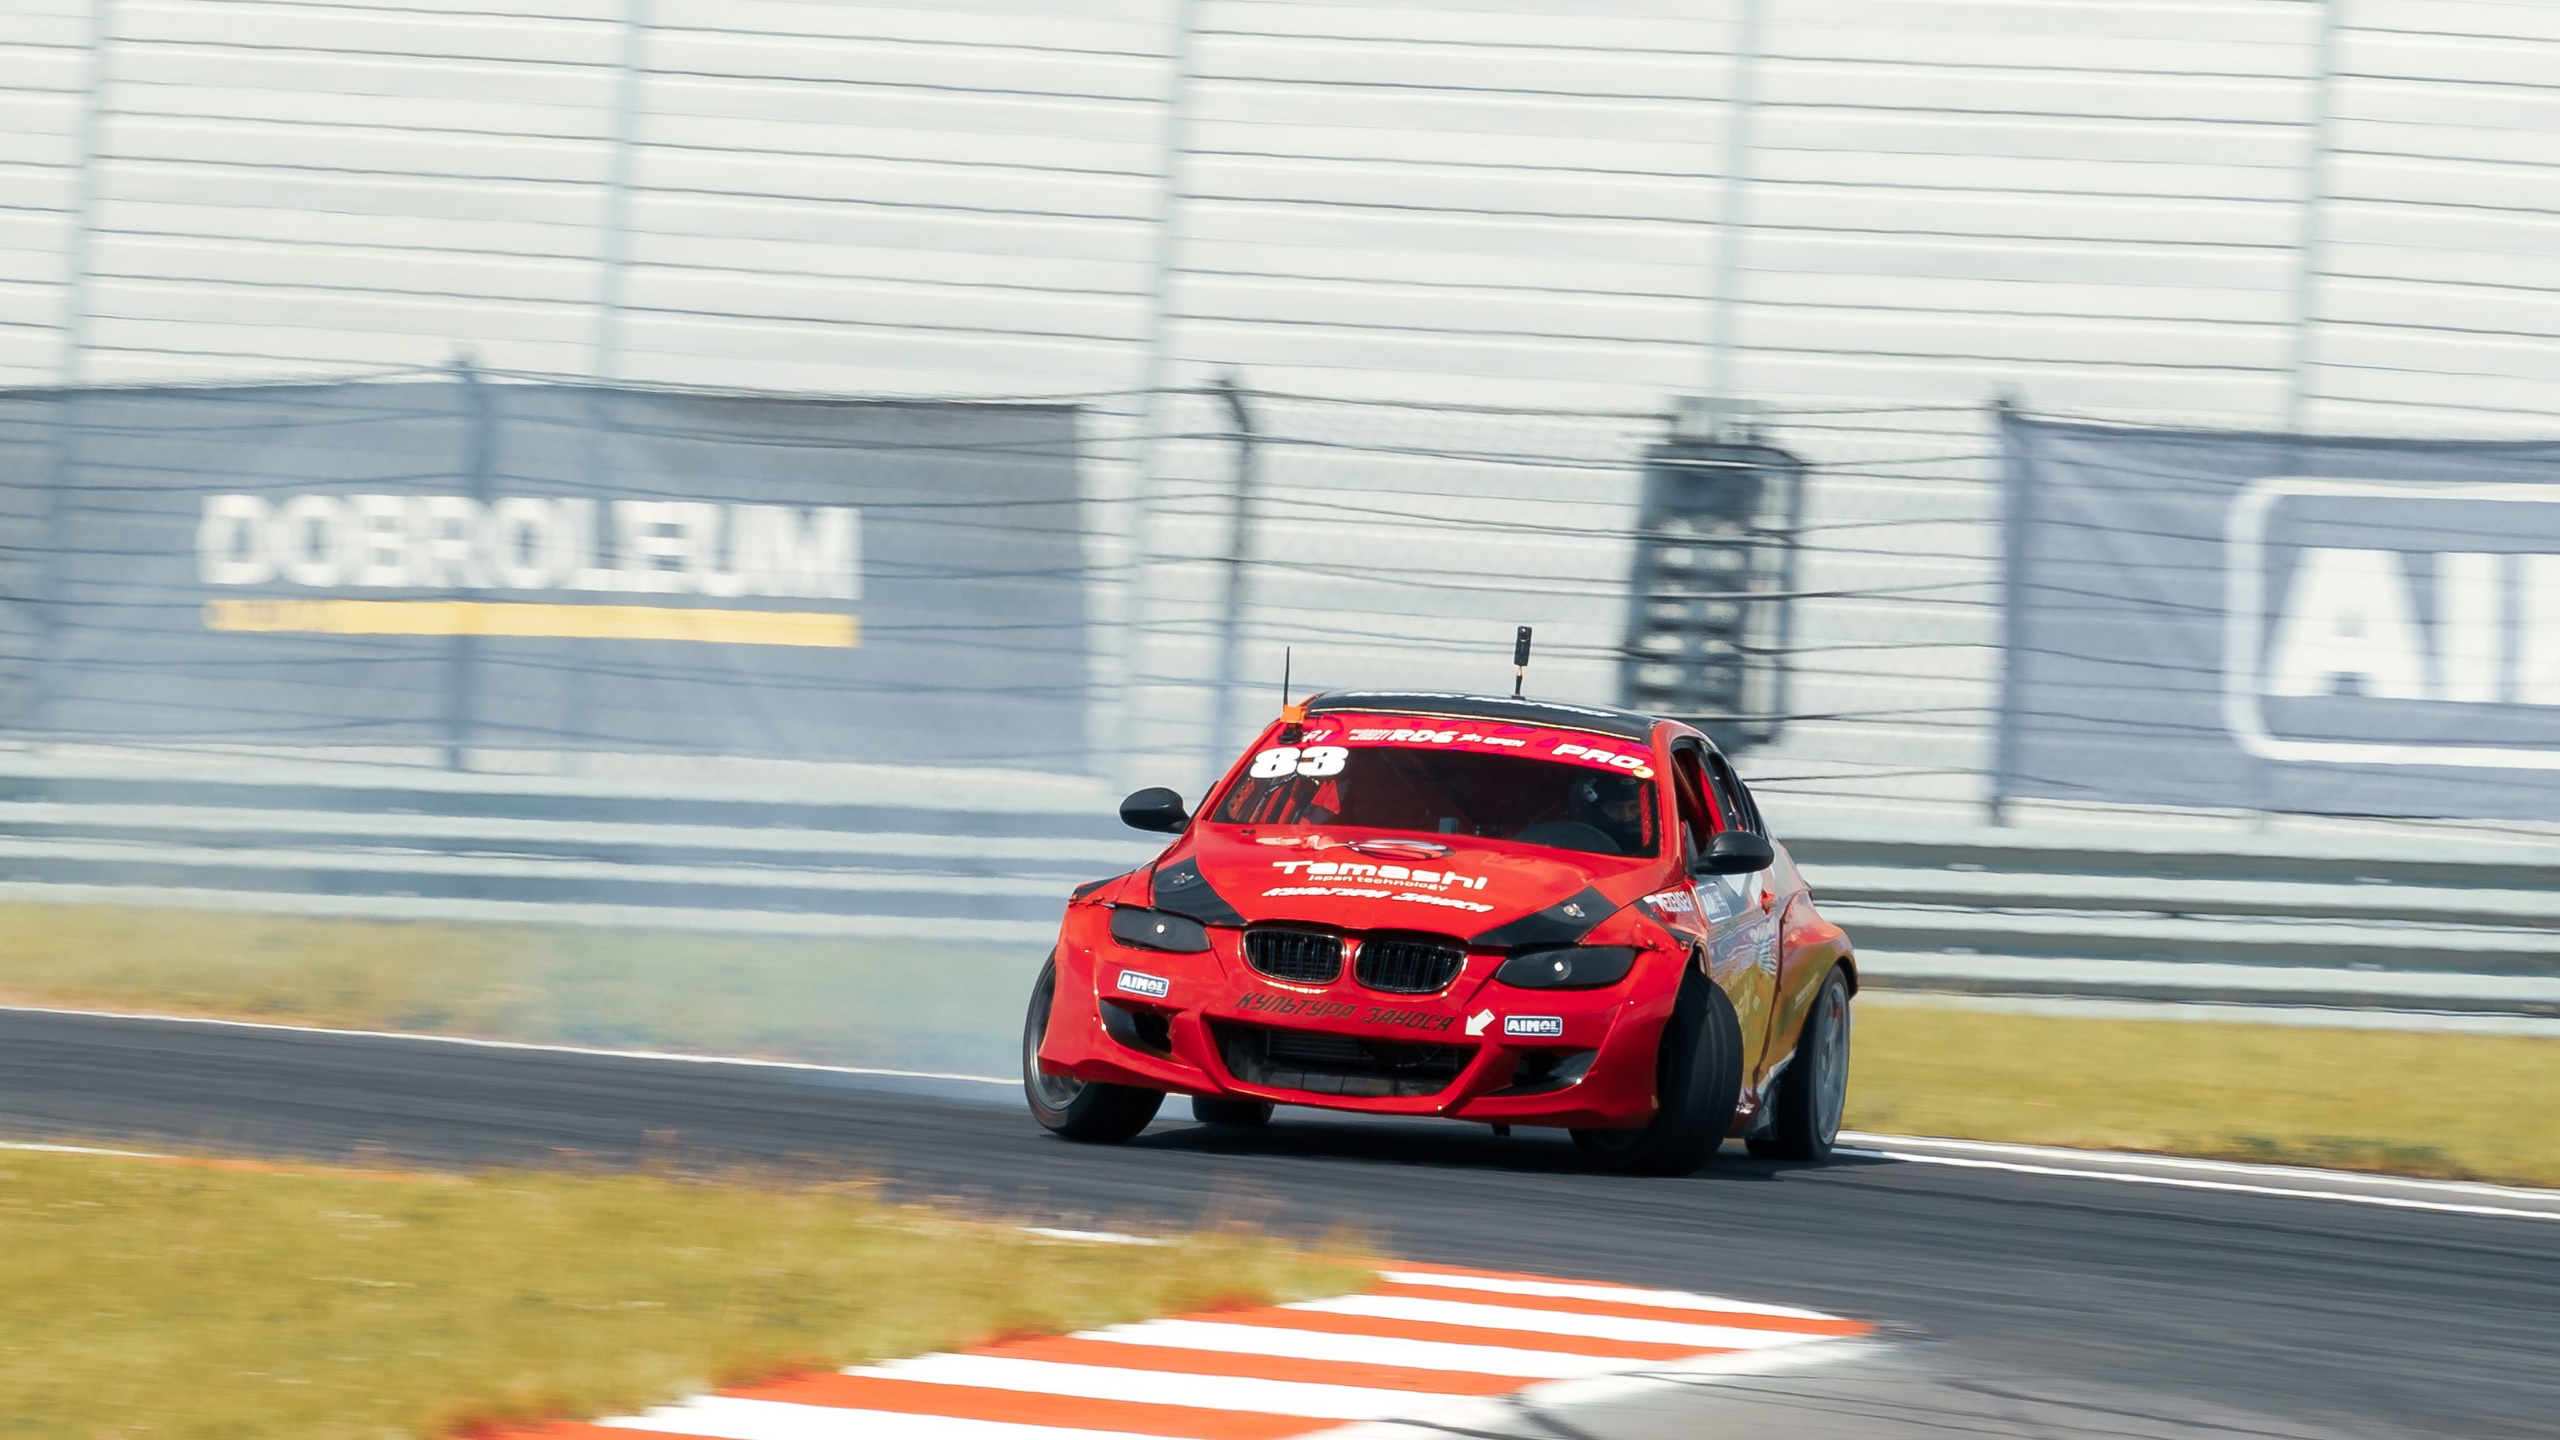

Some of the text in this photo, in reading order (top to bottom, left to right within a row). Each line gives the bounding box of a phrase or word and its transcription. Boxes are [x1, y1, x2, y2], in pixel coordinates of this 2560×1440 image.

[200, 494, 861, 600] DOBROLEUM
[1249, 745, 1349, 778] 83
[1551, 743, 1645, 769] PRO
[1272, 860, 1488, 890] Tamashi
[1356, 876, 1448, 892] technology
[1120, 975, 1164, 993] AIMOL
[1235, 992, 1455, 1032] КУЛЬТУРА ЗАНОСА
[1507, 1019, 1559, 1033] AIMOL
